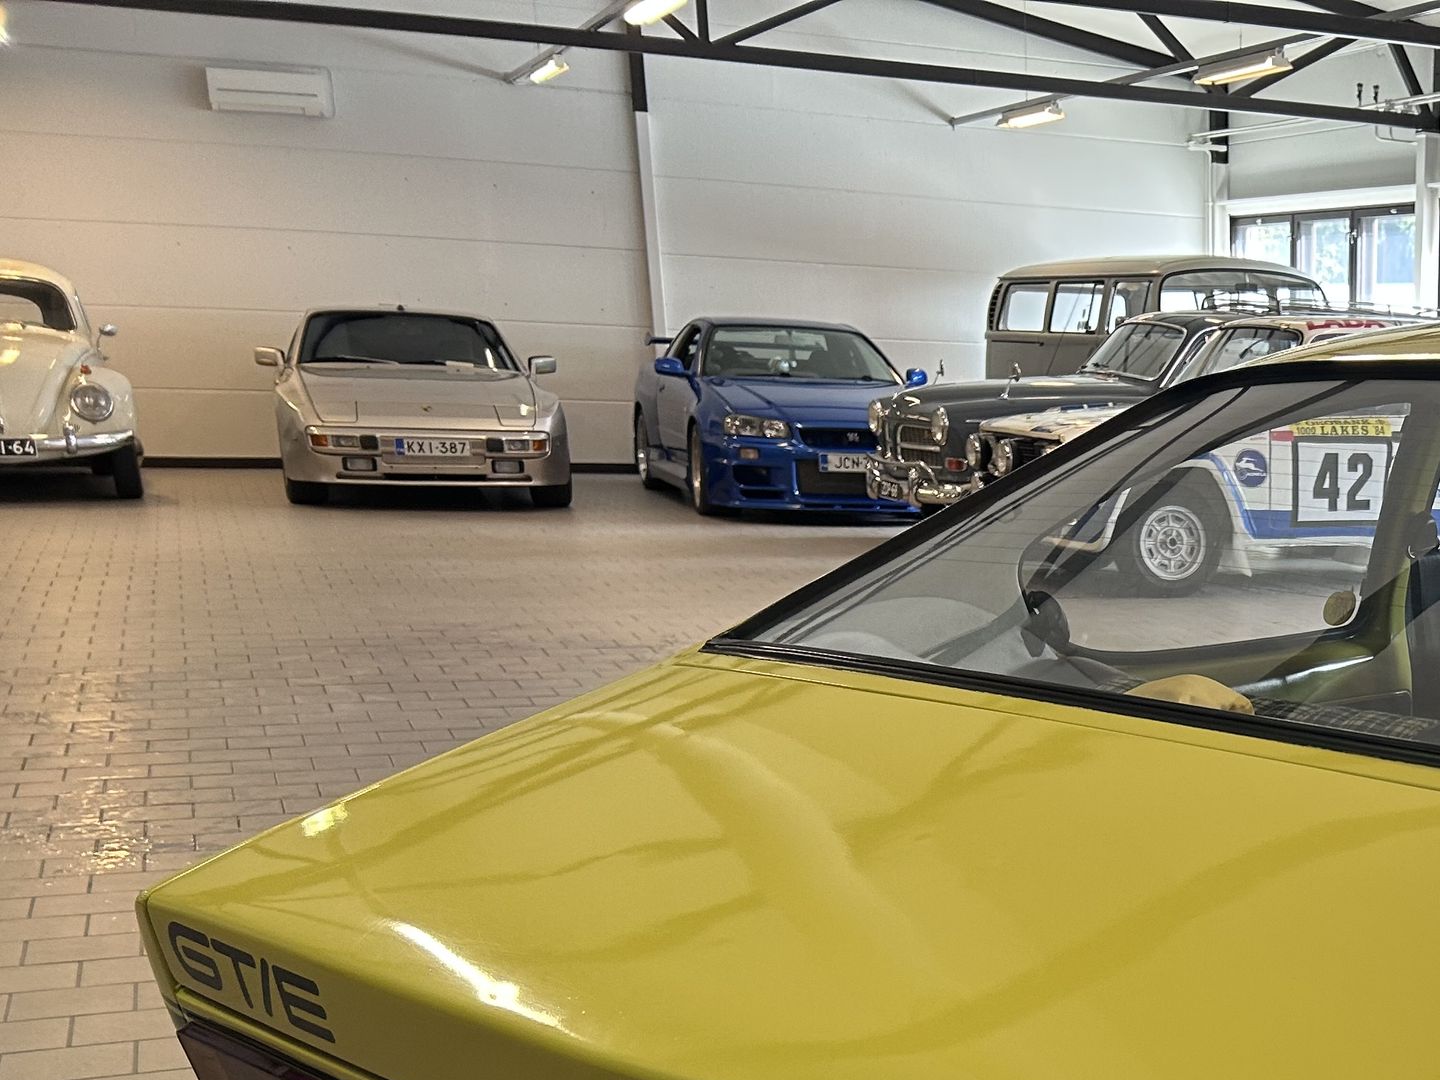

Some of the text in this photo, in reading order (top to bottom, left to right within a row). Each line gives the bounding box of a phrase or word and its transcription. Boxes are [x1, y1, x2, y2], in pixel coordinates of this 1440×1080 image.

[1320, 425, 1369, 436] LAKES
[406, 441, 466, 454] KXI-387
[1313, 453, 1373, 512] 42
